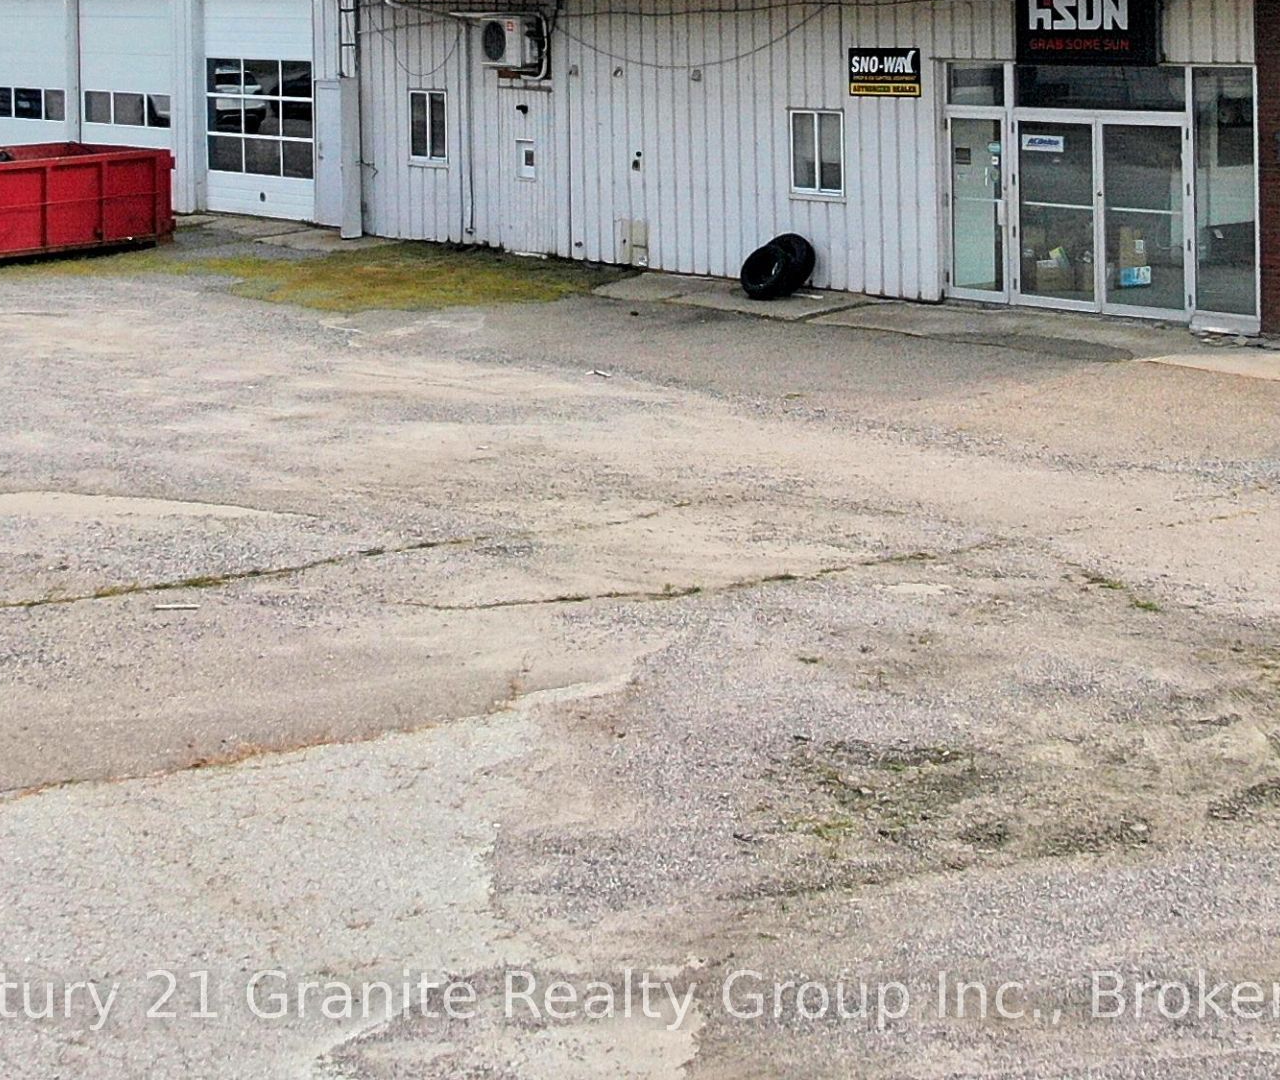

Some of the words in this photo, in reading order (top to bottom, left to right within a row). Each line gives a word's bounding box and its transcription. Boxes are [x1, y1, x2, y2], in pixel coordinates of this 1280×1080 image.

[1066, 38, 1101, 50] SOME
[1103, 38, 1130, 50] SUN
[851, 50, 916, 73] SNO-WAY
